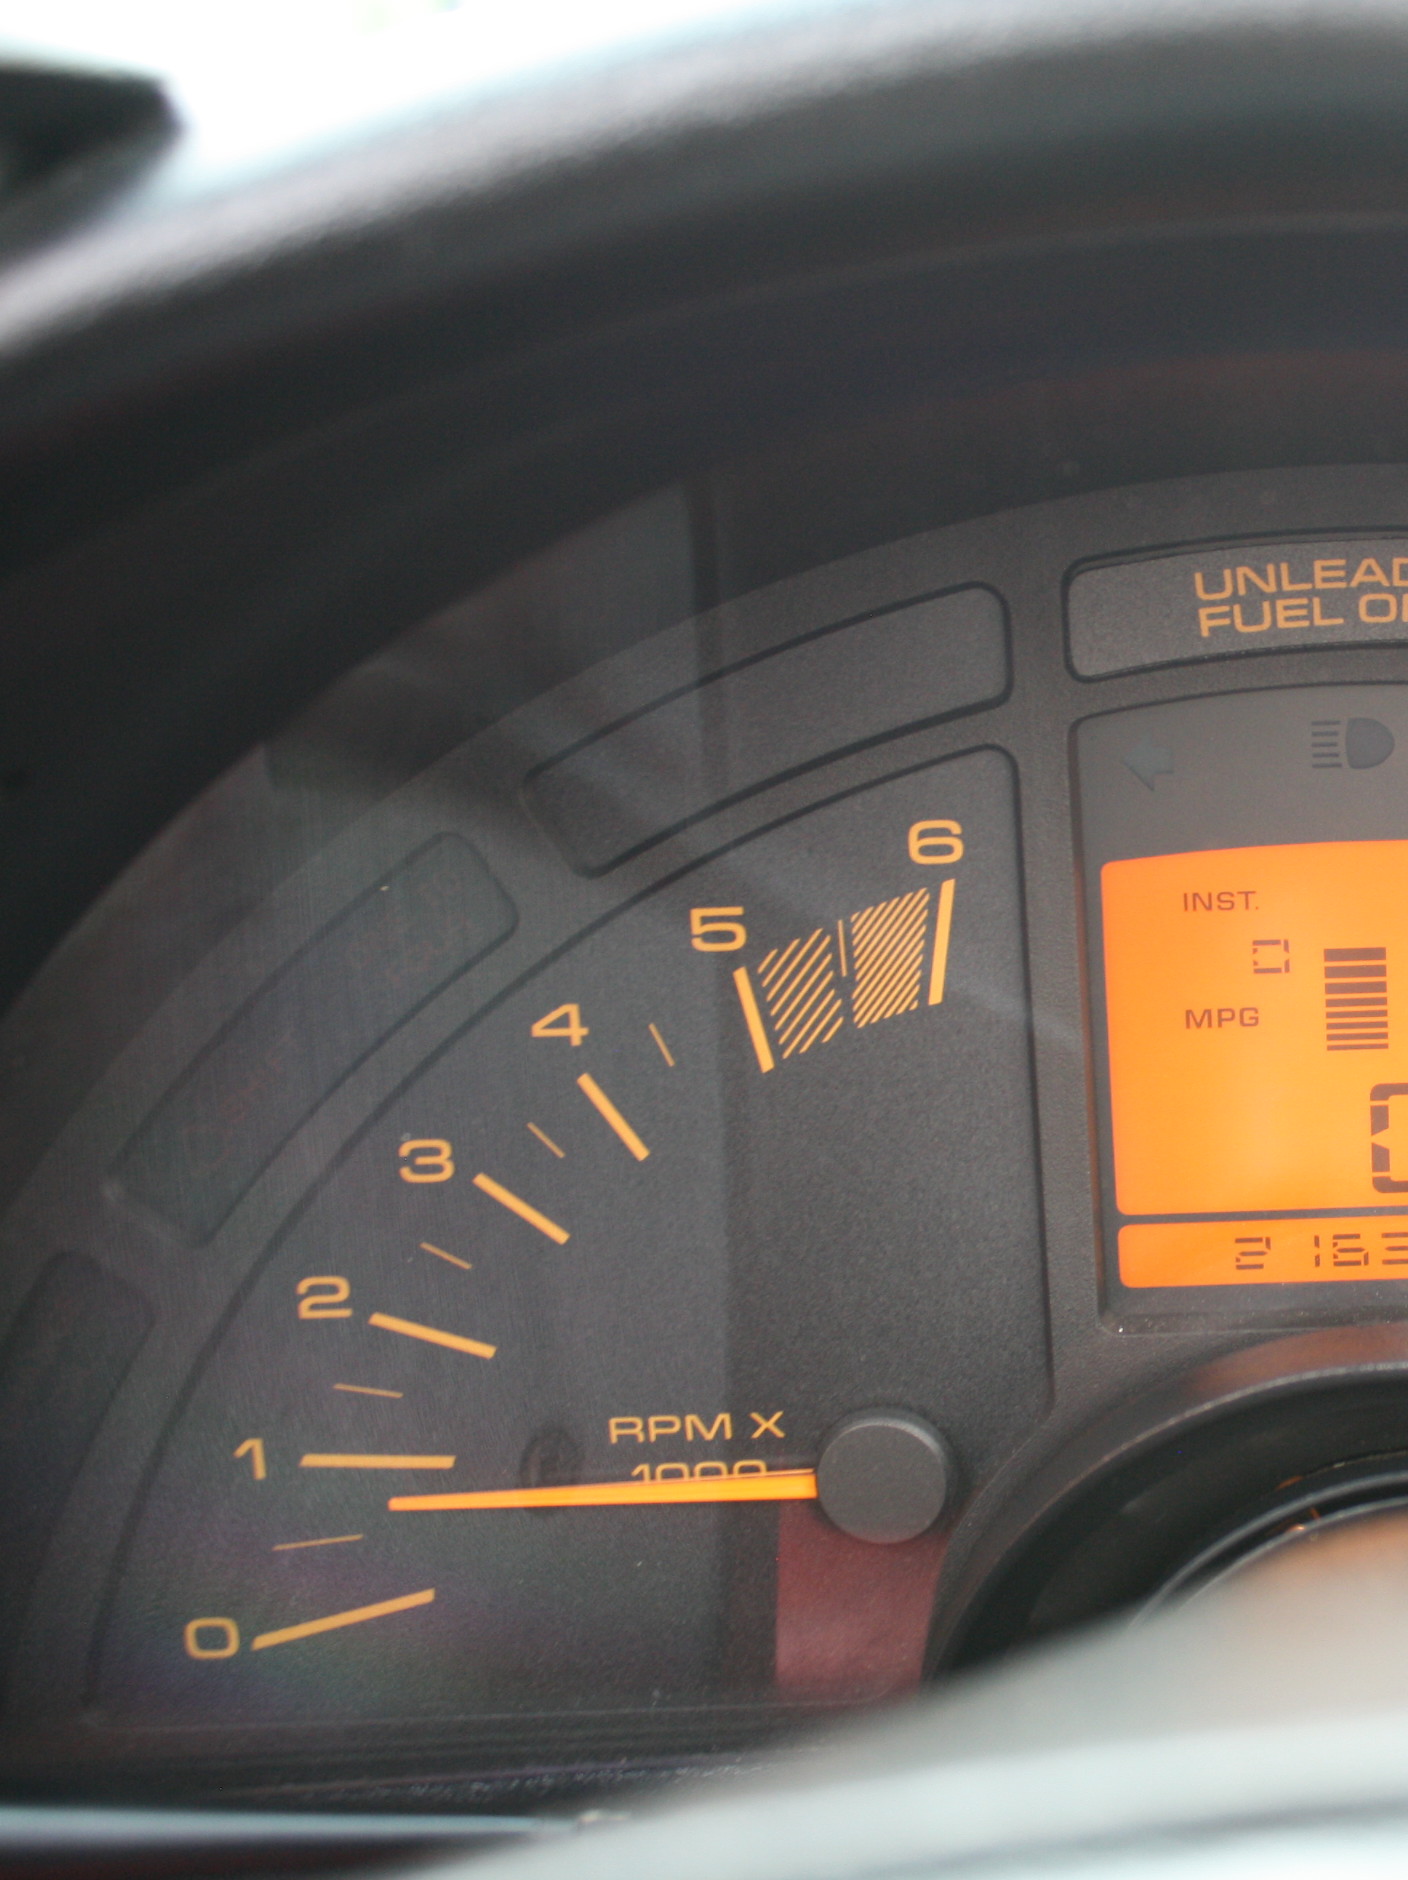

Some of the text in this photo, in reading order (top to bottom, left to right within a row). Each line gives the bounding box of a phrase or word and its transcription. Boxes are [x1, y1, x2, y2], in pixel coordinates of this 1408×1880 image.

[1198, 596, 1344, 637] FUEL
[908, 819, 964, 865] 6
[1183, 890, 1259, 911] INST.
[690, 906, 747, 952] 5
[1253, 939, 1290, 974] 0
[531, 1004, 589, 1046] 4
[1185, 1007, 1259, 1028] MPG
[399, 1139, 454, 1183] 3
[296, 1276, 352, 1319] 2
[608, 1412, 785, 1443] RPM X
[234, 1438, 266, 1480] 1
[184, 1617, 240, 1659] 0
